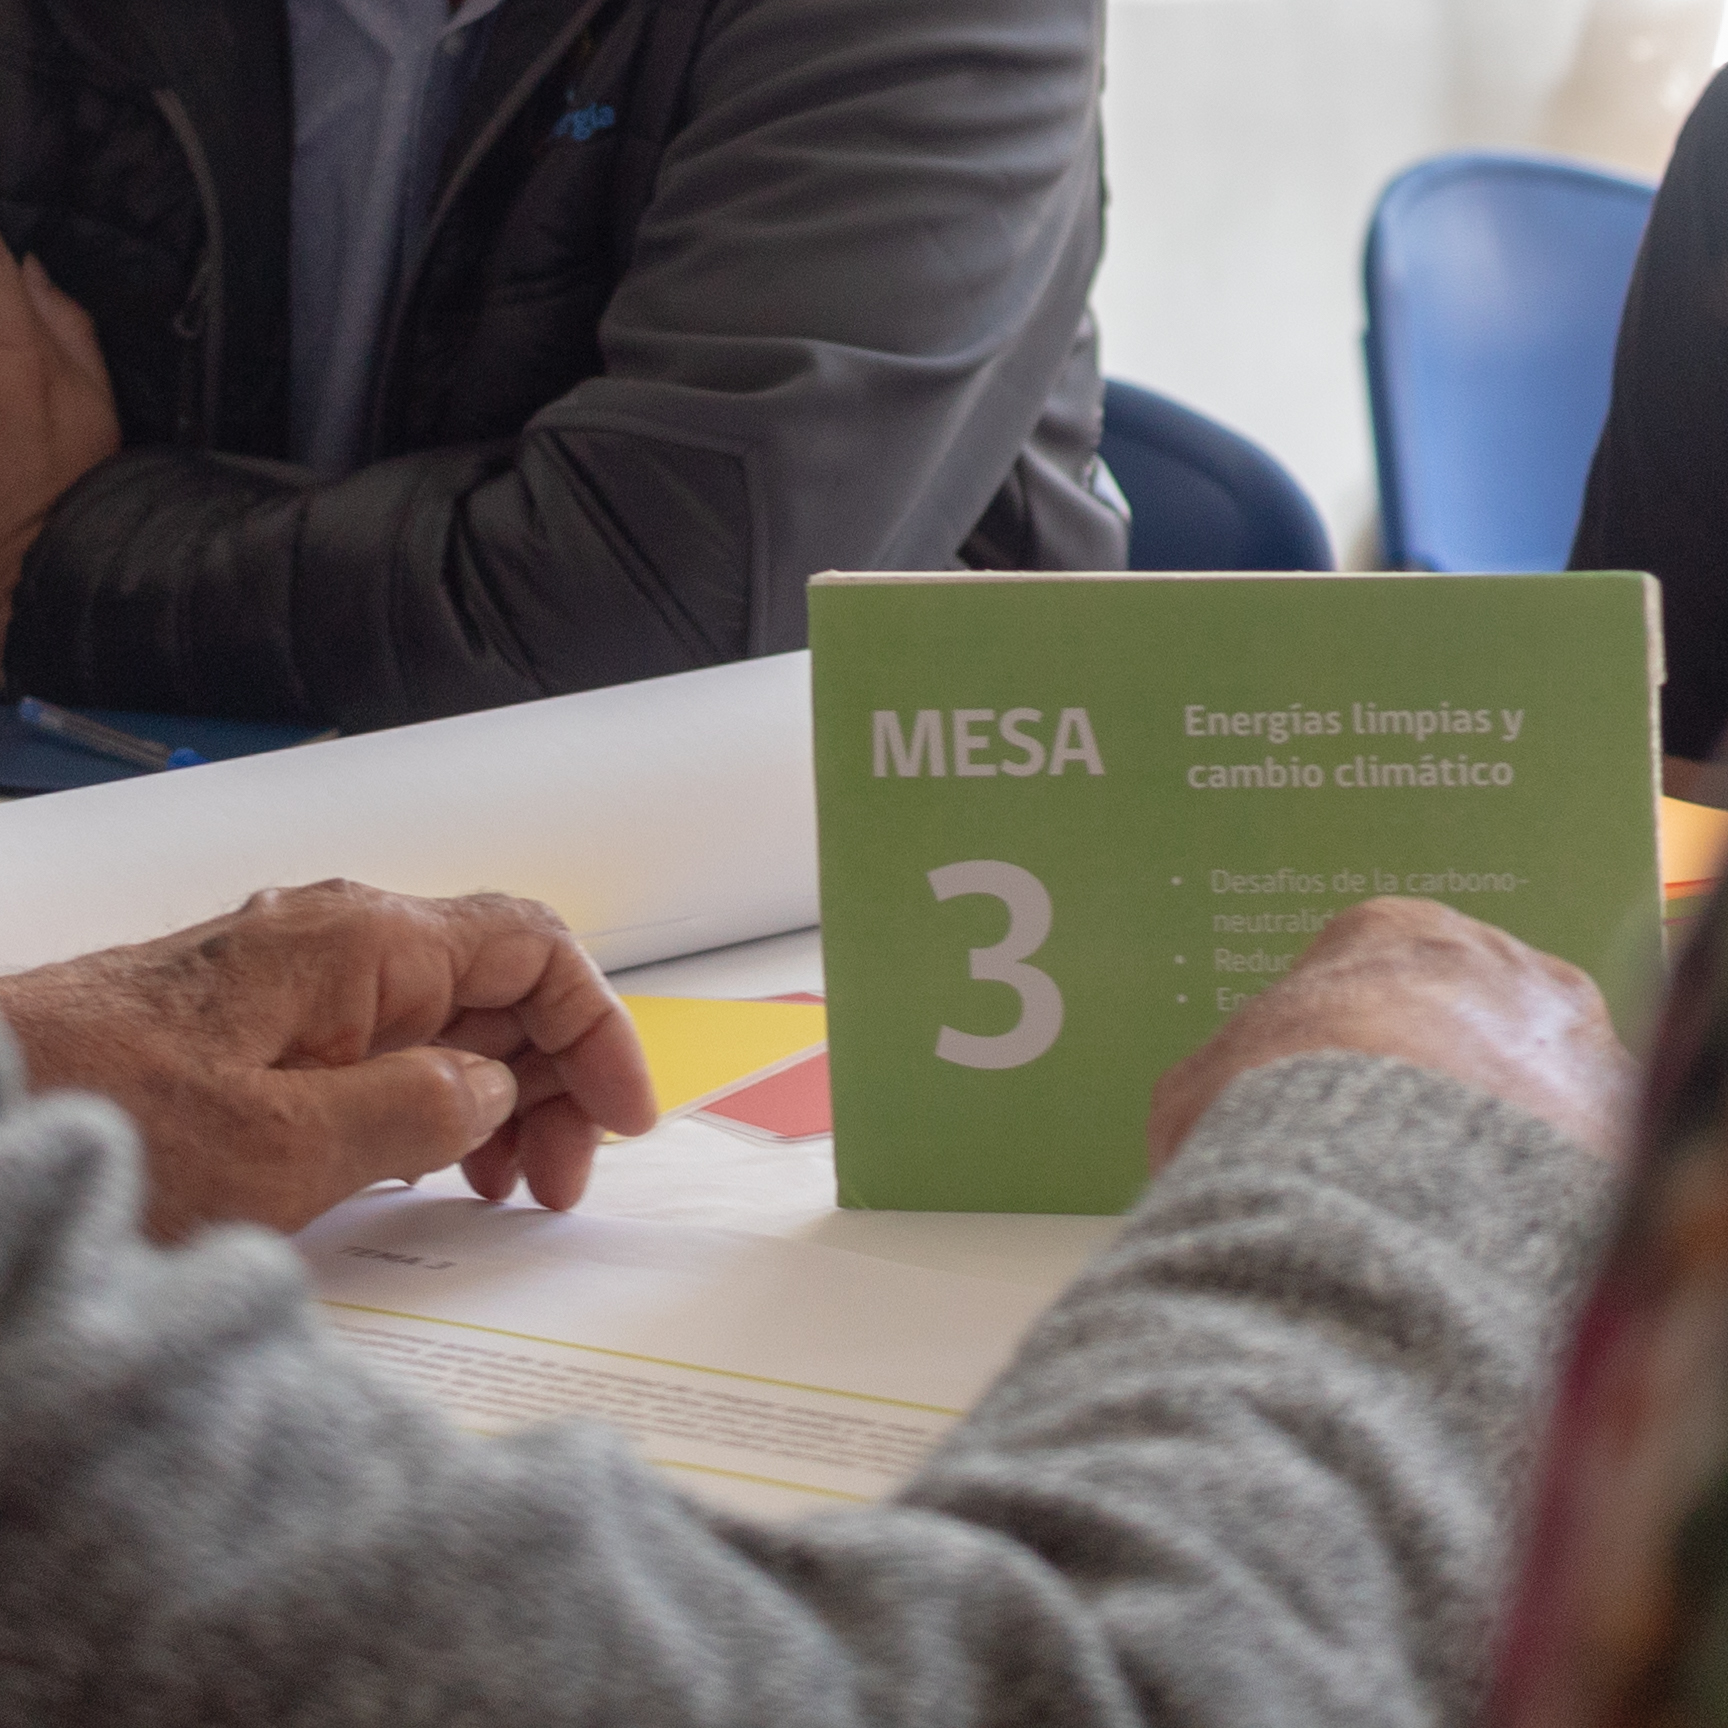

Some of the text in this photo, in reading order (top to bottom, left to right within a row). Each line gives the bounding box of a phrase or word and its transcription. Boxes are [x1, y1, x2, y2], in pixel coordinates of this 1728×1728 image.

[872, 707, 1106, 778] MESA
[1184, 701, 1525, 744] Energías limpias y
[1187, 754, 1515, 788] cambio climático
[1332, 869, 1368, 893] de
[1374, 869, 1399, 892] la
[926, 859, 1065, 1070] 3
